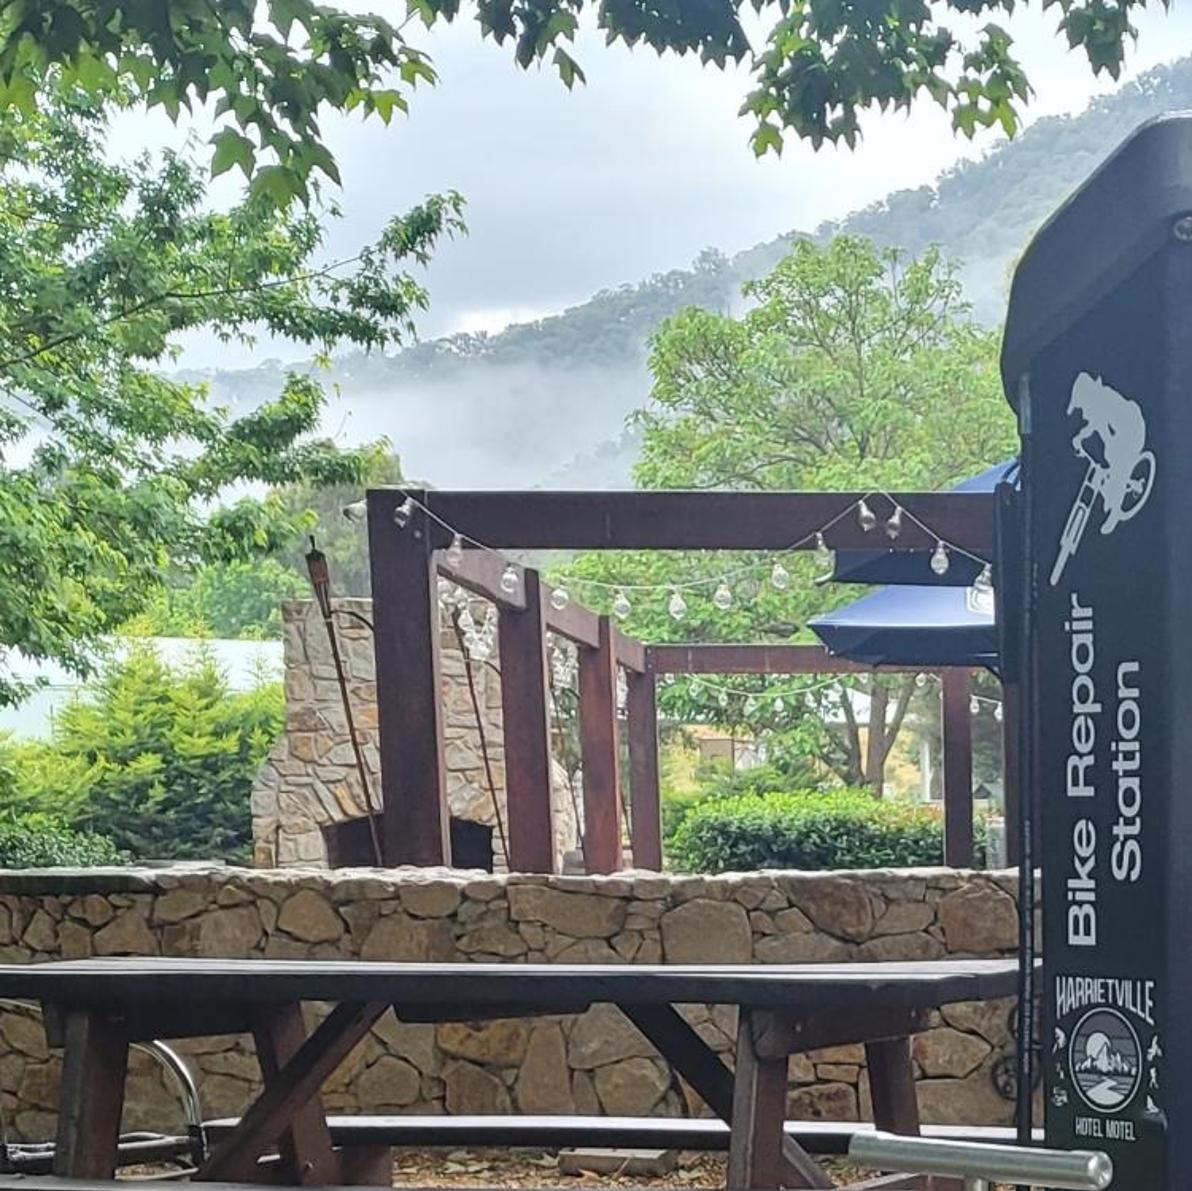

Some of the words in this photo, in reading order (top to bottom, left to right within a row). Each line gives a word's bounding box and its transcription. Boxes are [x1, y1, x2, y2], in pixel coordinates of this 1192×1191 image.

[1064, 593, 1102, 797] Repair
[1110, 661, 1142, 882] Station
[1067, 819, 1096, 946] Bike
[1056, 976, 1155, 1026] HARRIETVILLE
[1075, 1116, 1103, 1137] HOTEL
[1105, 1119, 1136, 1141] MOTEL
